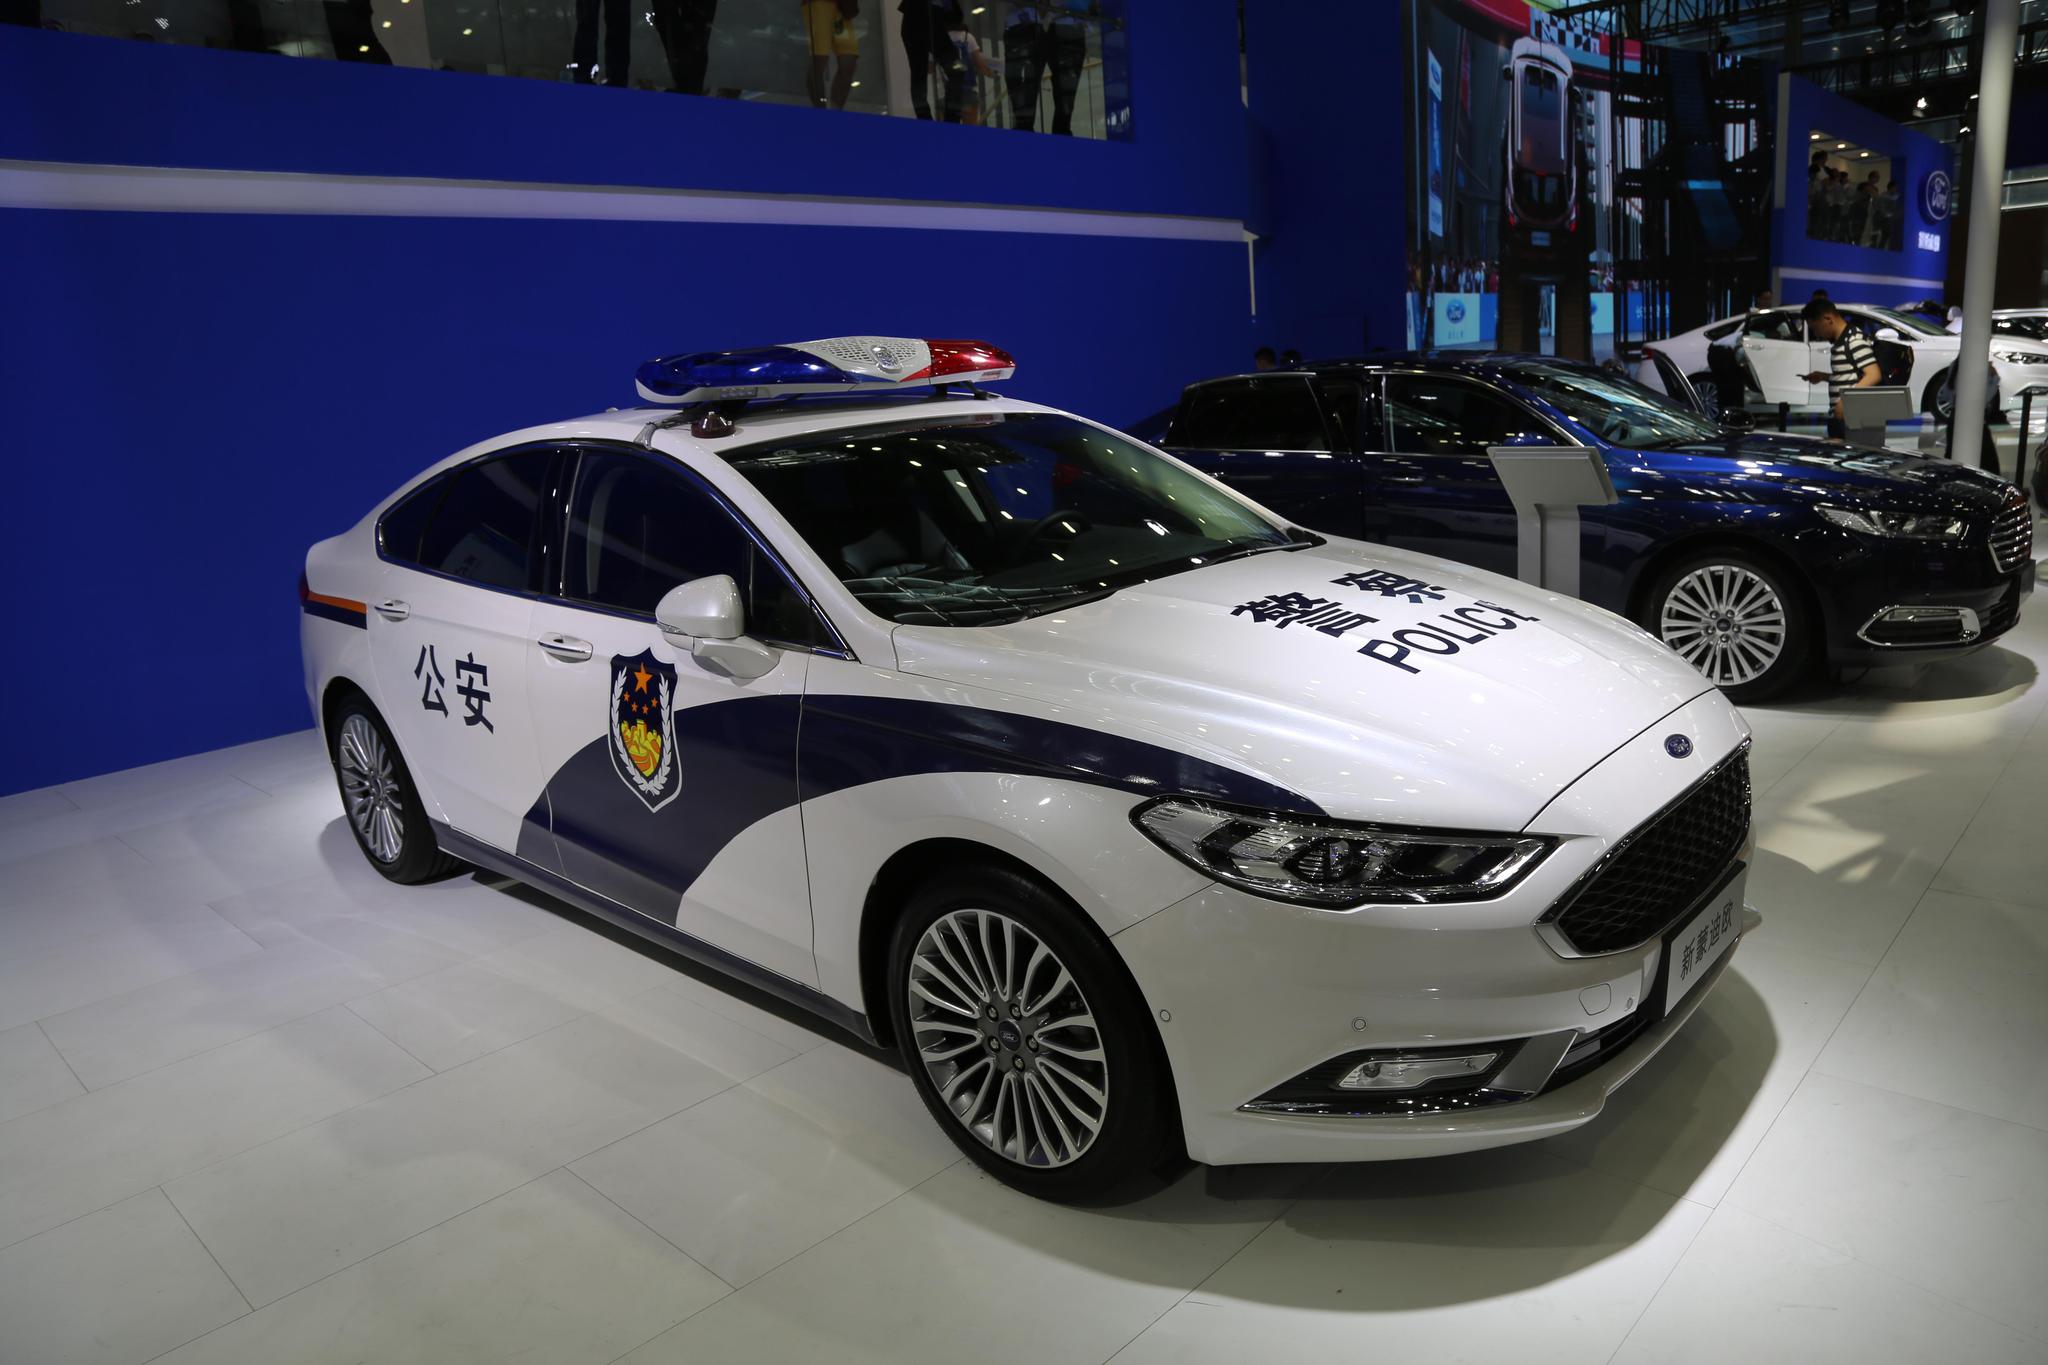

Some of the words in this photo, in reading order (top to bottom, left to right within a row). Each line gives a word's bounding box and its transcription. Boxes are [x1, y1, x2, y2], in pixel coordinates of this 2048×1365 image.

[1230, 569, 1449, 638] 警察
[414, 644, 494, 734] 公安
[1681, 900, 1734, 981] 新蒙迪欧
